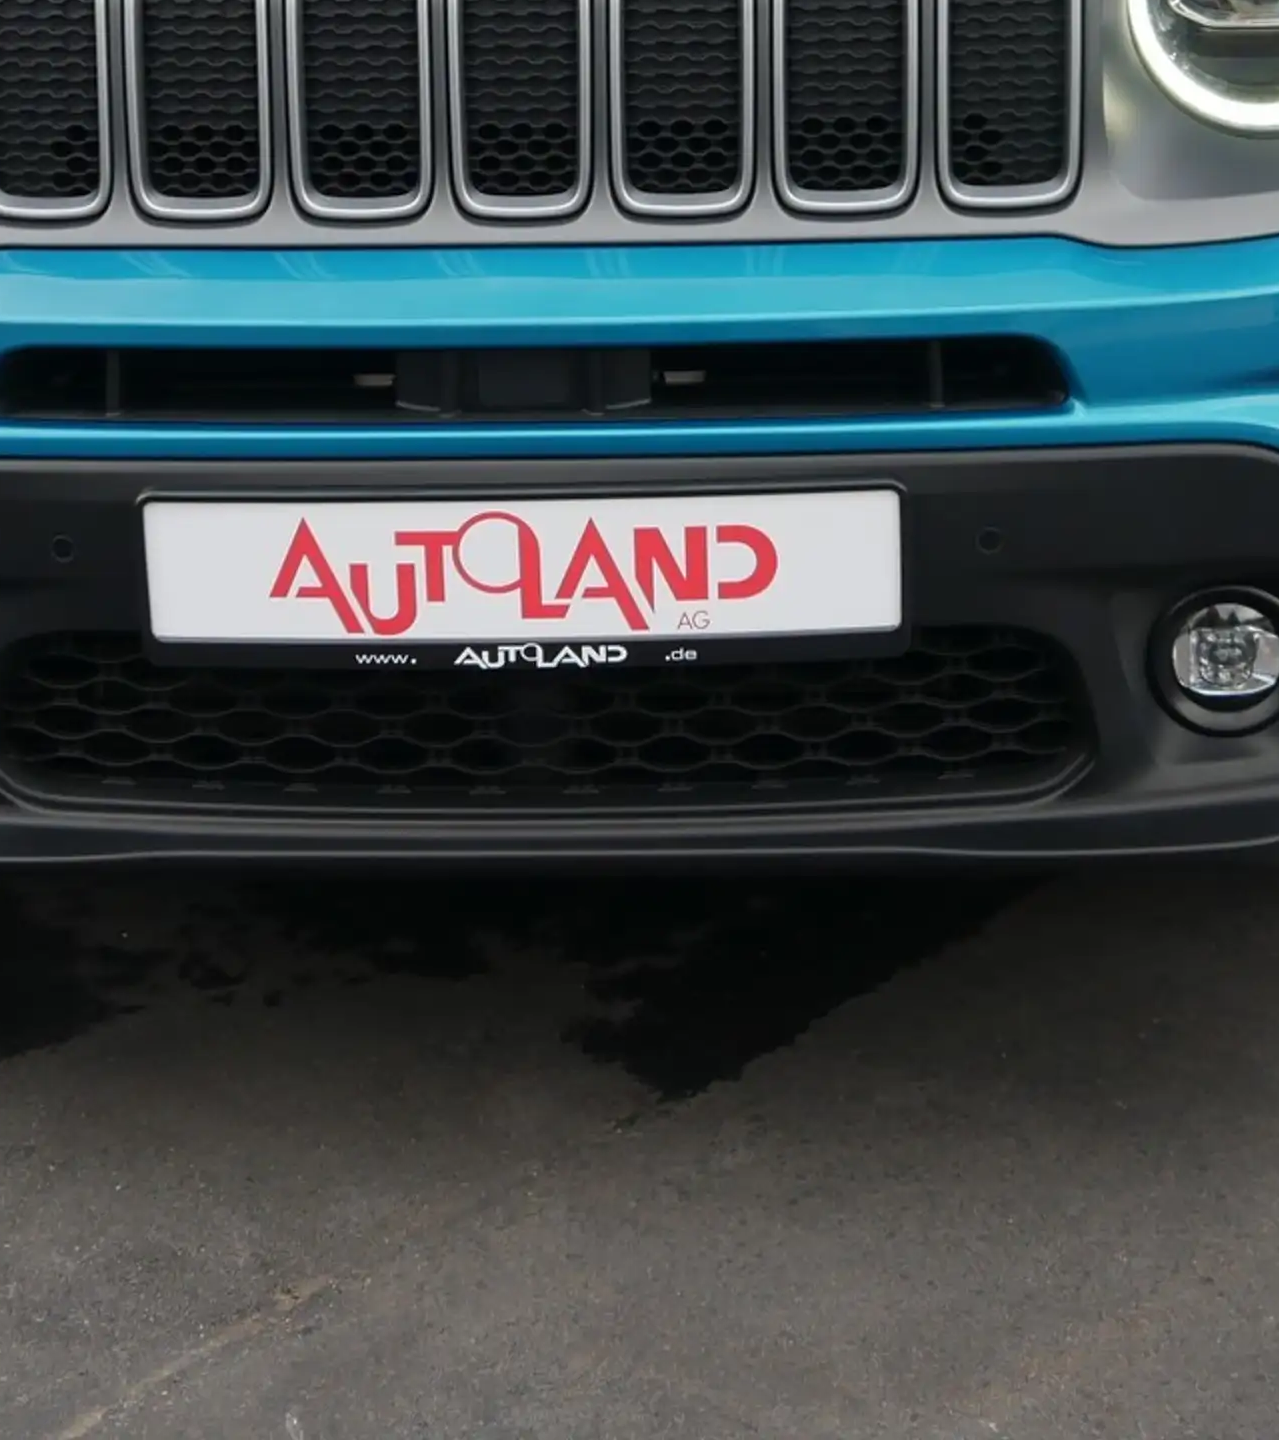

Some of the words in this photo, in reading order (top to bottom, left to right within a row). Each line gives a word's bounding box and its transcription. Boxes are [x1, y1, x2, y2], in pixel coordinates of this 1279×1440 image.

[676, 609, 712, 631] AG
[355, 653, 417, 665] www.
[664, 647, 698, 661] .de
